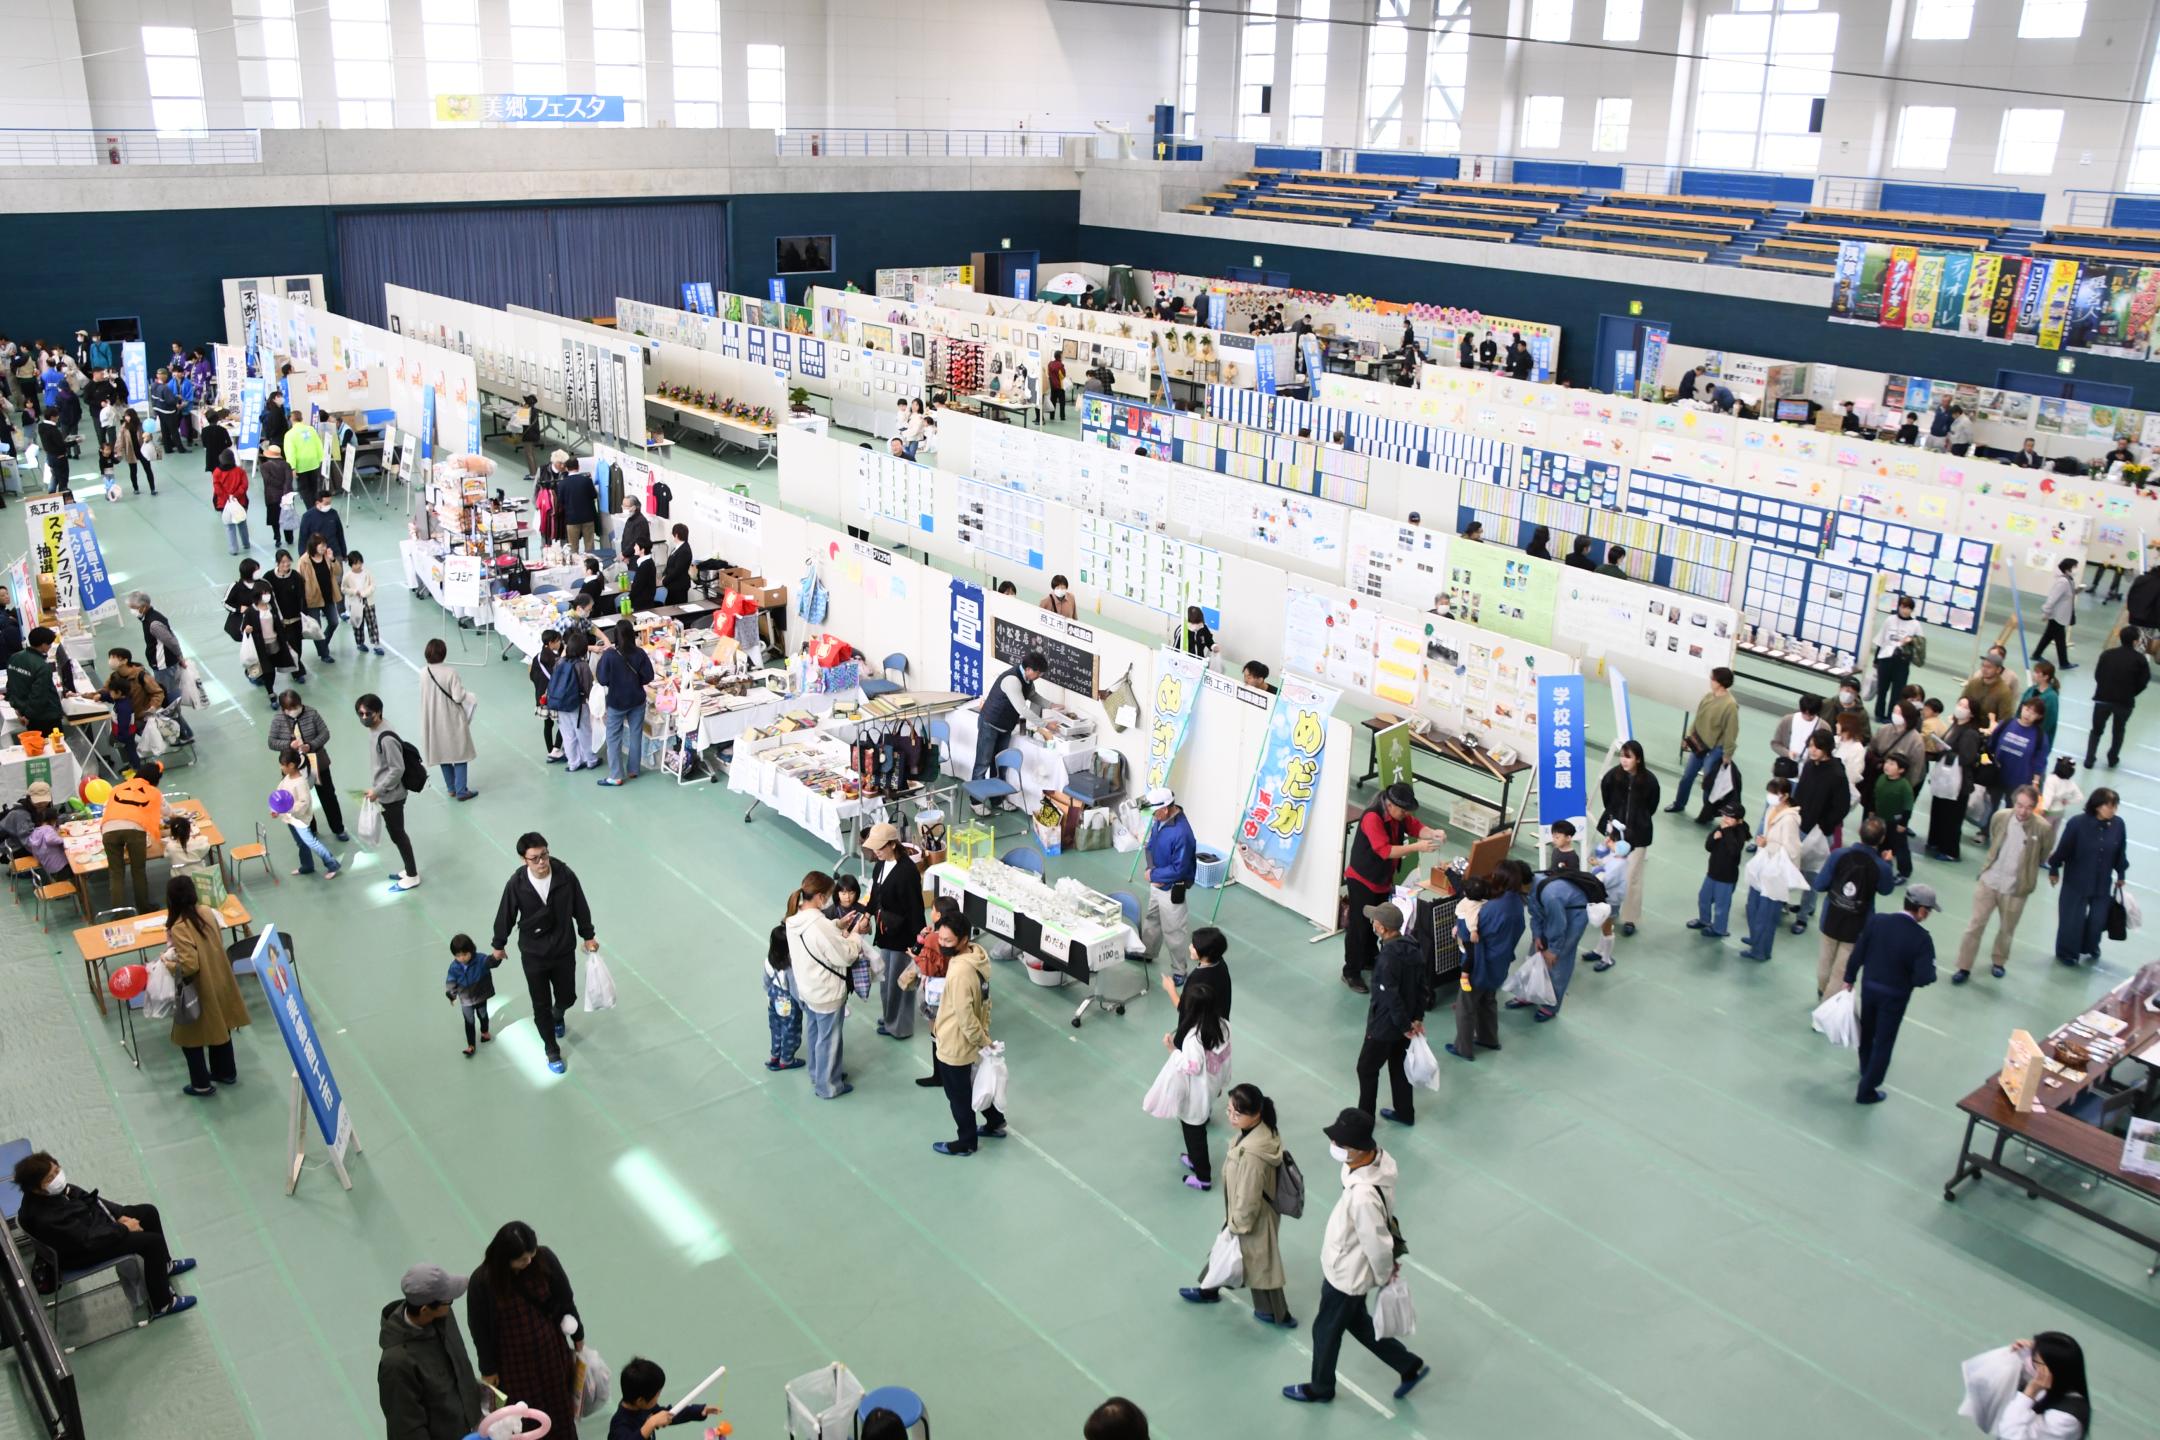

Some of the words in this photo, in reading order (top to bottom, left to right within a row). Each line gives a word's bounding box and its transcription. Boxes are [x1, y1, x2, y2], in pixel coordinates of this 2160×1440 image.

[485, 96, 606, 120] 美郷フェスタ
[29, 501, 60, 517] 商工市
[70, 533, 96, 605] スタンプラリー
[953, 594, 981, 651] 畳
[1040, 613, 1065, 631] 商工市
[1203, 674, 1233, 695] 商工市
[1552, 687, 1572, 790] 学校給食展
[1269, 709, 1326, 837] めだか
[1242, 788, 1274, 839] 販売中
[1043, 934, 1067, 951] めだか
